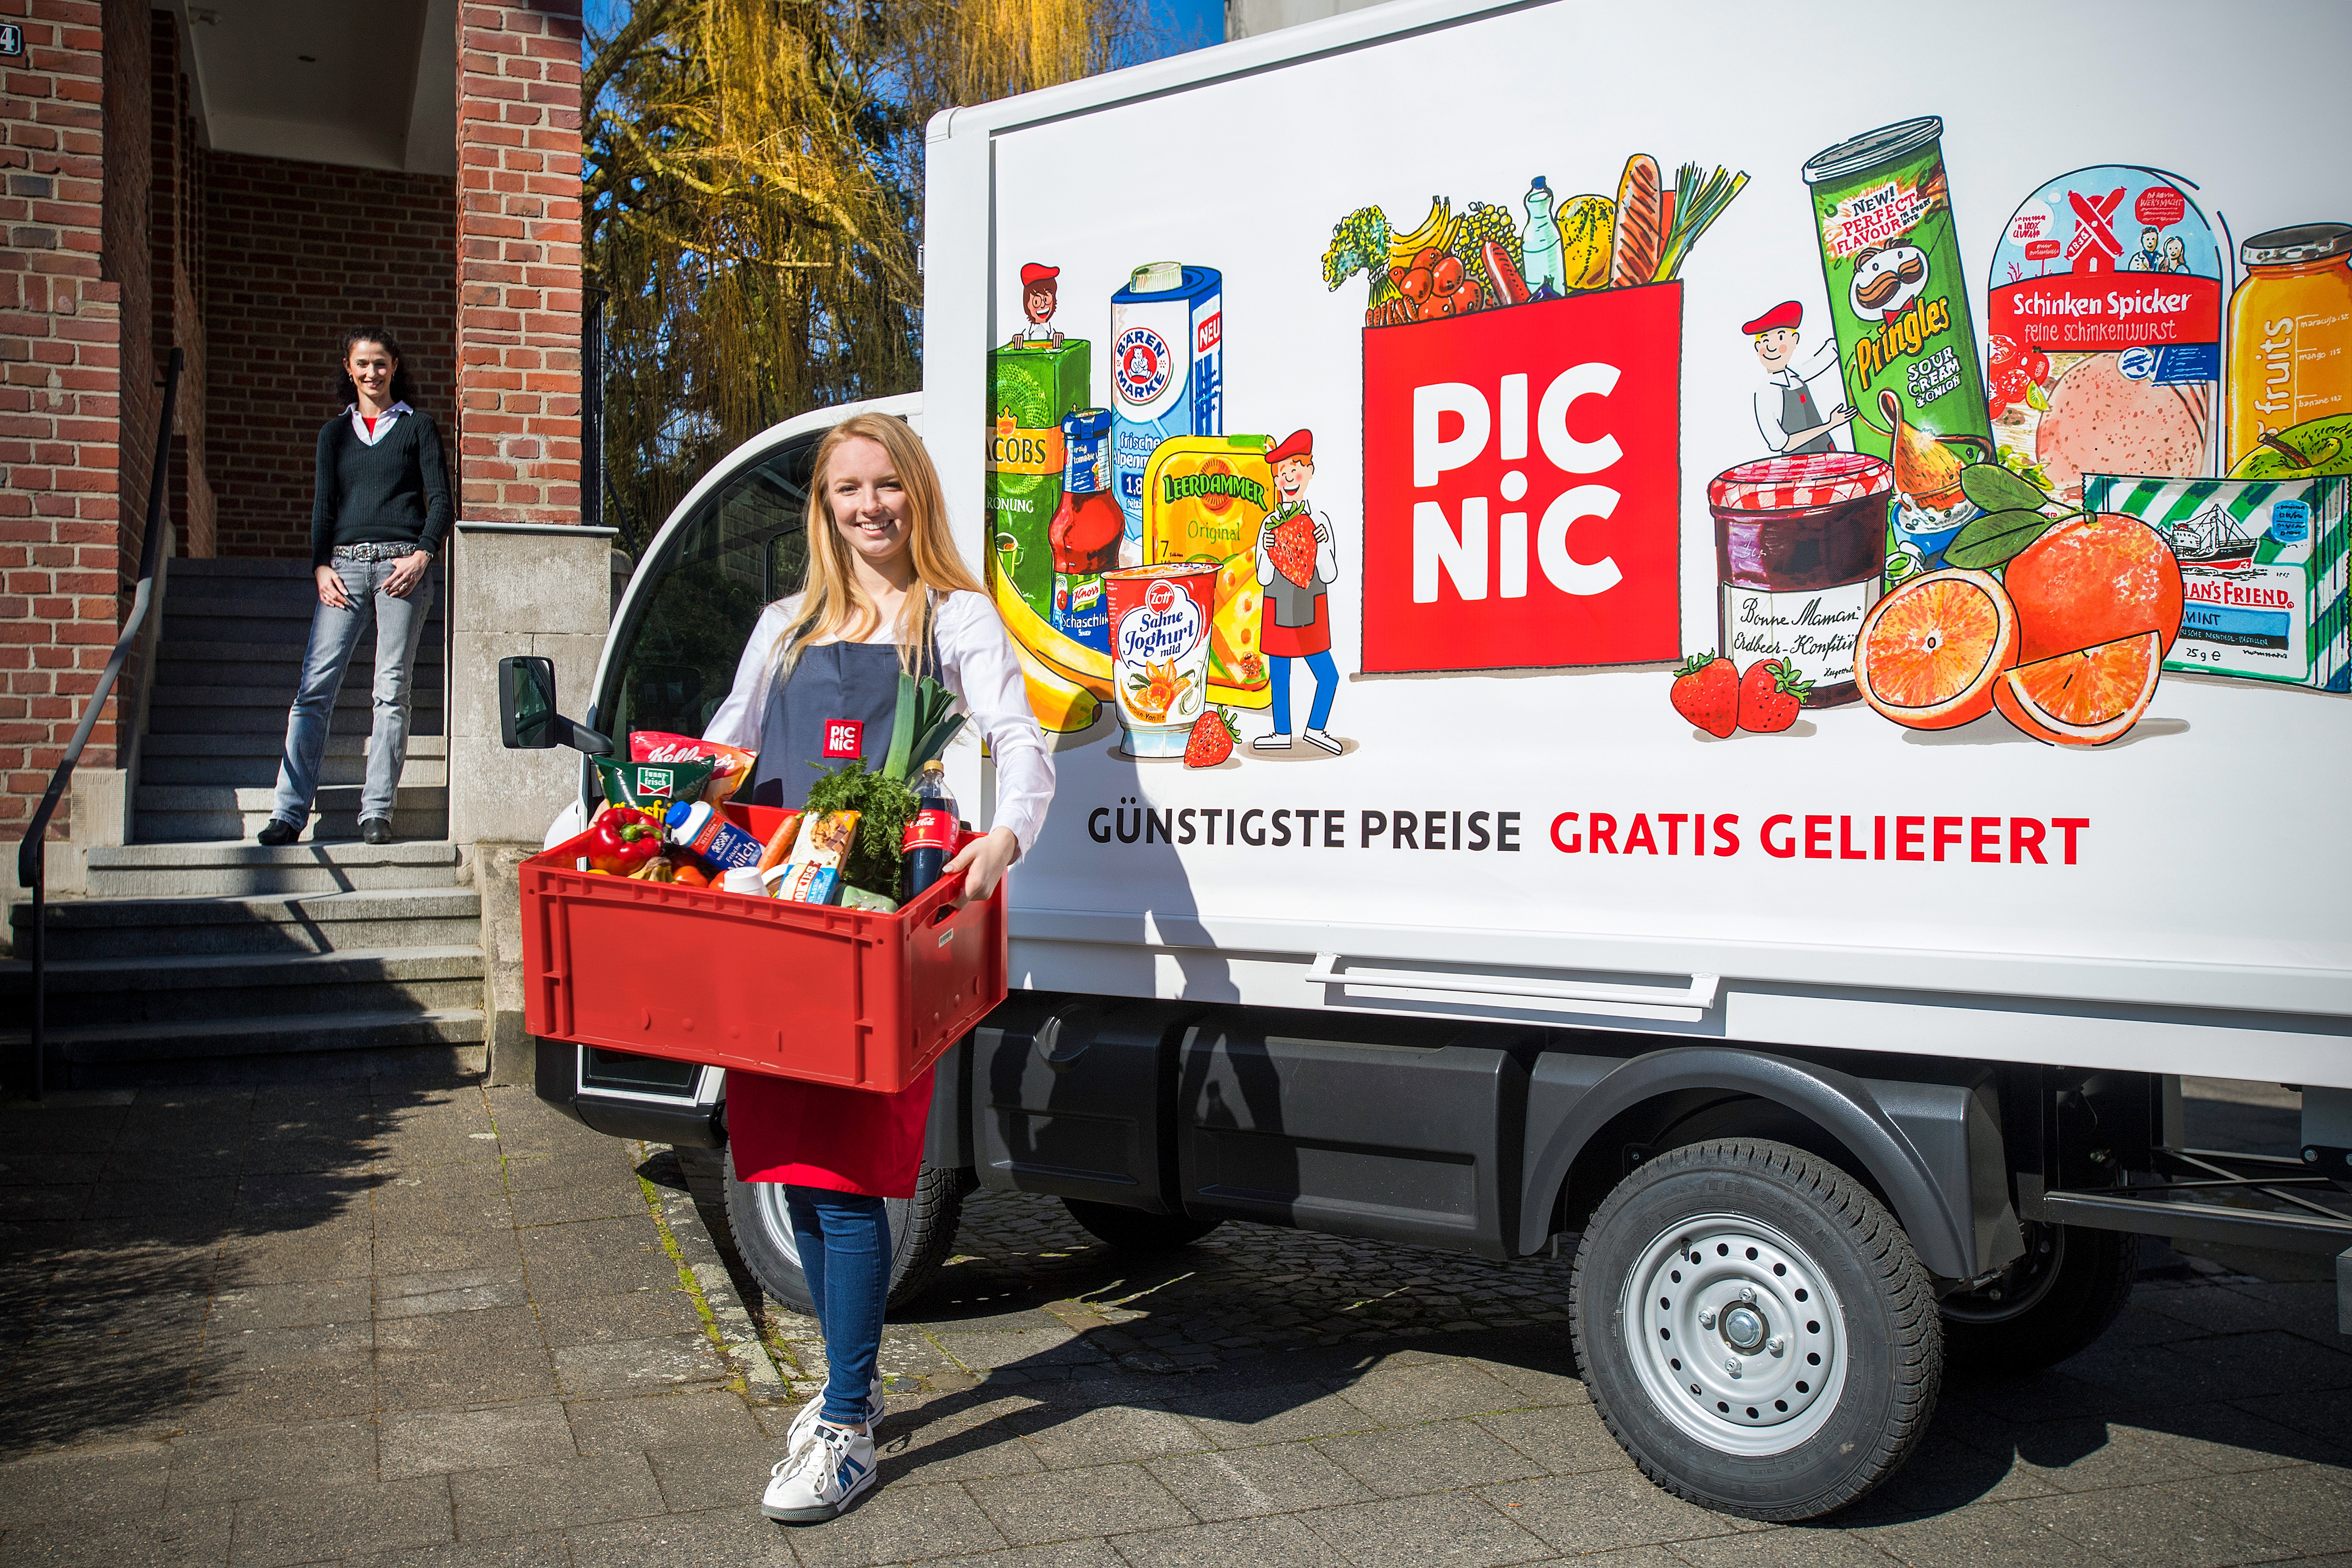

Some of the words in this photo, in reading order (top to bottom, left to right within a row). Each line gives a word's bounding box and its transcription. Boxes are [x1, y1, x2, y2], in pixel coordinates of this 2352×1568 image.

[0, 28, 15, 51] 4
[1852, 186, 1895, 216] NEW!
[1842, 193, 1915, 237] PERFECT
[1837, 219, 1901, 254] FLAVOUR
[2013, 291, 2102, 317] Schinken
[2107, 288, 2192, 320] Spicker
[1117, 330, 1165, 358] BÄREN
[1200, 317, 1220, 348] NEU
[1855, 295, 1951, 392] Pringles
[1907, 346, 1954, 381] SOUR
[2254, 317, 2294, 414] fruits
[2299, 352, 2326, 361] mango
[1118, 370, 1165, 398] MARKE
[1908, 357, 1962, 396] CREAM
[2299, 397, 2329, 407] banane
[1120, 431, 1160, 451] frische
[1163, 473, 1268, 511] LEERDAMMER
[1188, 520, 1240, 544] Original
[1160, 540, 1169, 557] 7
[1073, 586, 1099, 603] Knorr
[1151, 591, 1174, 604] Zott
[2224, 581, 2288, 605] FRIEND
[1061, 612, 1108, 628] Schaschlik
[1140, 611, 1184, 632] Sahne
[1740, 597, 1789, 626] Bonne
[1791, 597, 1859, 626] Maman
[2184, 611, 2221, 626] MINT
[1123, 620, 1194, 657] Joghurt
[1160, 643, 1180, 657] mild
[1125, 697, 1165, 721] Bourbon-Vanille
[644, 777, 667, 786] frisch
[645, 770, 668, 779] funny-
[1088, 797, 1344, 847] GÜNSTIGSTE
[1362, 811, 1520, 851] PREISE
[1550, 812, 1740, 857] GRATIS
[1760, 814, 2089, 865] GELIEFERT
[716, 834, 738, 861] Weihenstephan
[726, 842, 742, 862] Frische
[727, 841, 757, 870] Milch
[808, 878, 821, 902] CLASSIC
